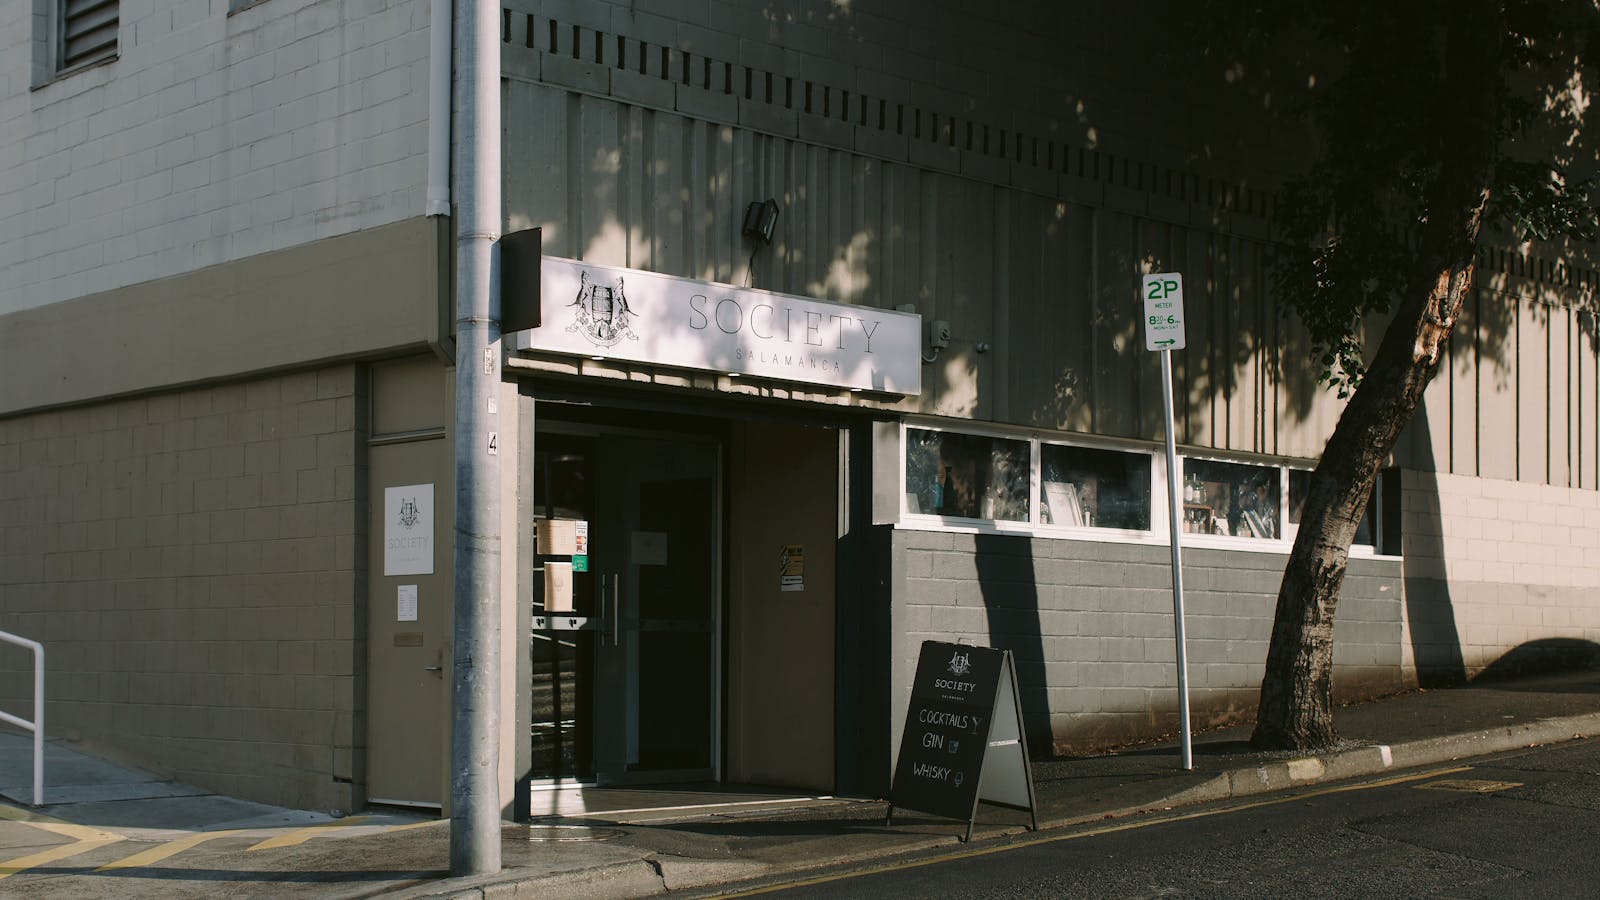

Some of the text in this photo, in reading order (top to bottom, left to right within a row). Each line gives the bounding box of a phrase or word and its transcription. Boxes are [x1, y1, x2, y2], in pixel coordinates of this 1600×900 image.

[1147, 280, 1178, 299] 2P
[688, 294, 881, 353] SOCIETY
[735, 347, 841, 373] SALAMANCA
[489, 433, 497, 452] 4
[388, 535, 429, 550] SOCIETY
[934, 678, 976, 693] SOCIETY
[919, 708, 968, 729] COCKTAILS
[922, 732, 944, 749] GIN
[913, 761, 951, 781] WHISKY
